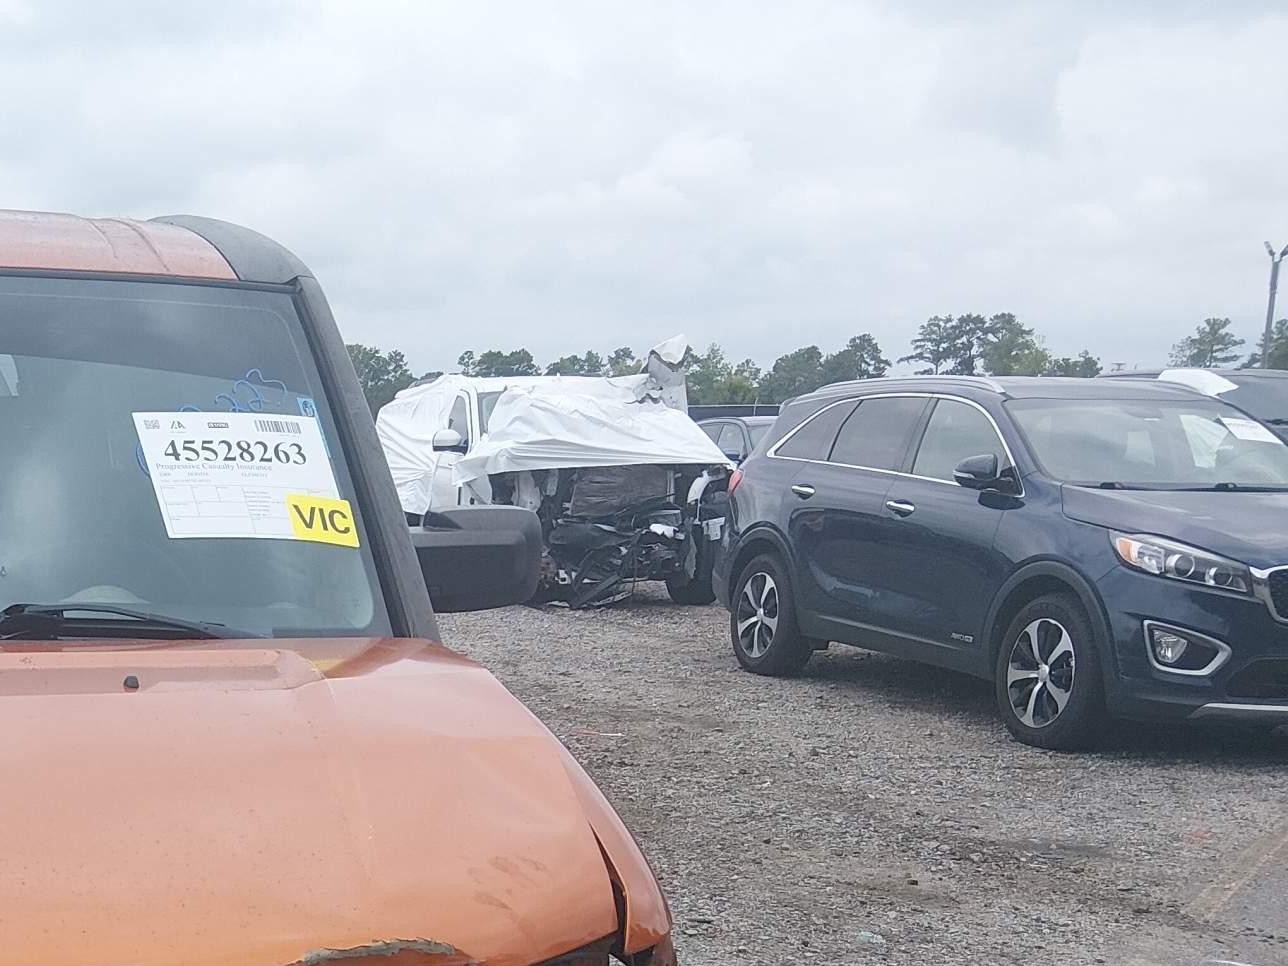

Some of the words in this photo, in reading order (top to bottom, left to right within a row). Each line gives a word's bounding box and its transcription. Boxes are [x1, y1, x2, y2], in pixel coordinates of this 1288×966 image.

[164, 440, 307, 466] 45528263
[156, 463, 201, 471] Progressive
[236, 463, 272, 471] Insurance
[293, 504, 350, 534] VIC
